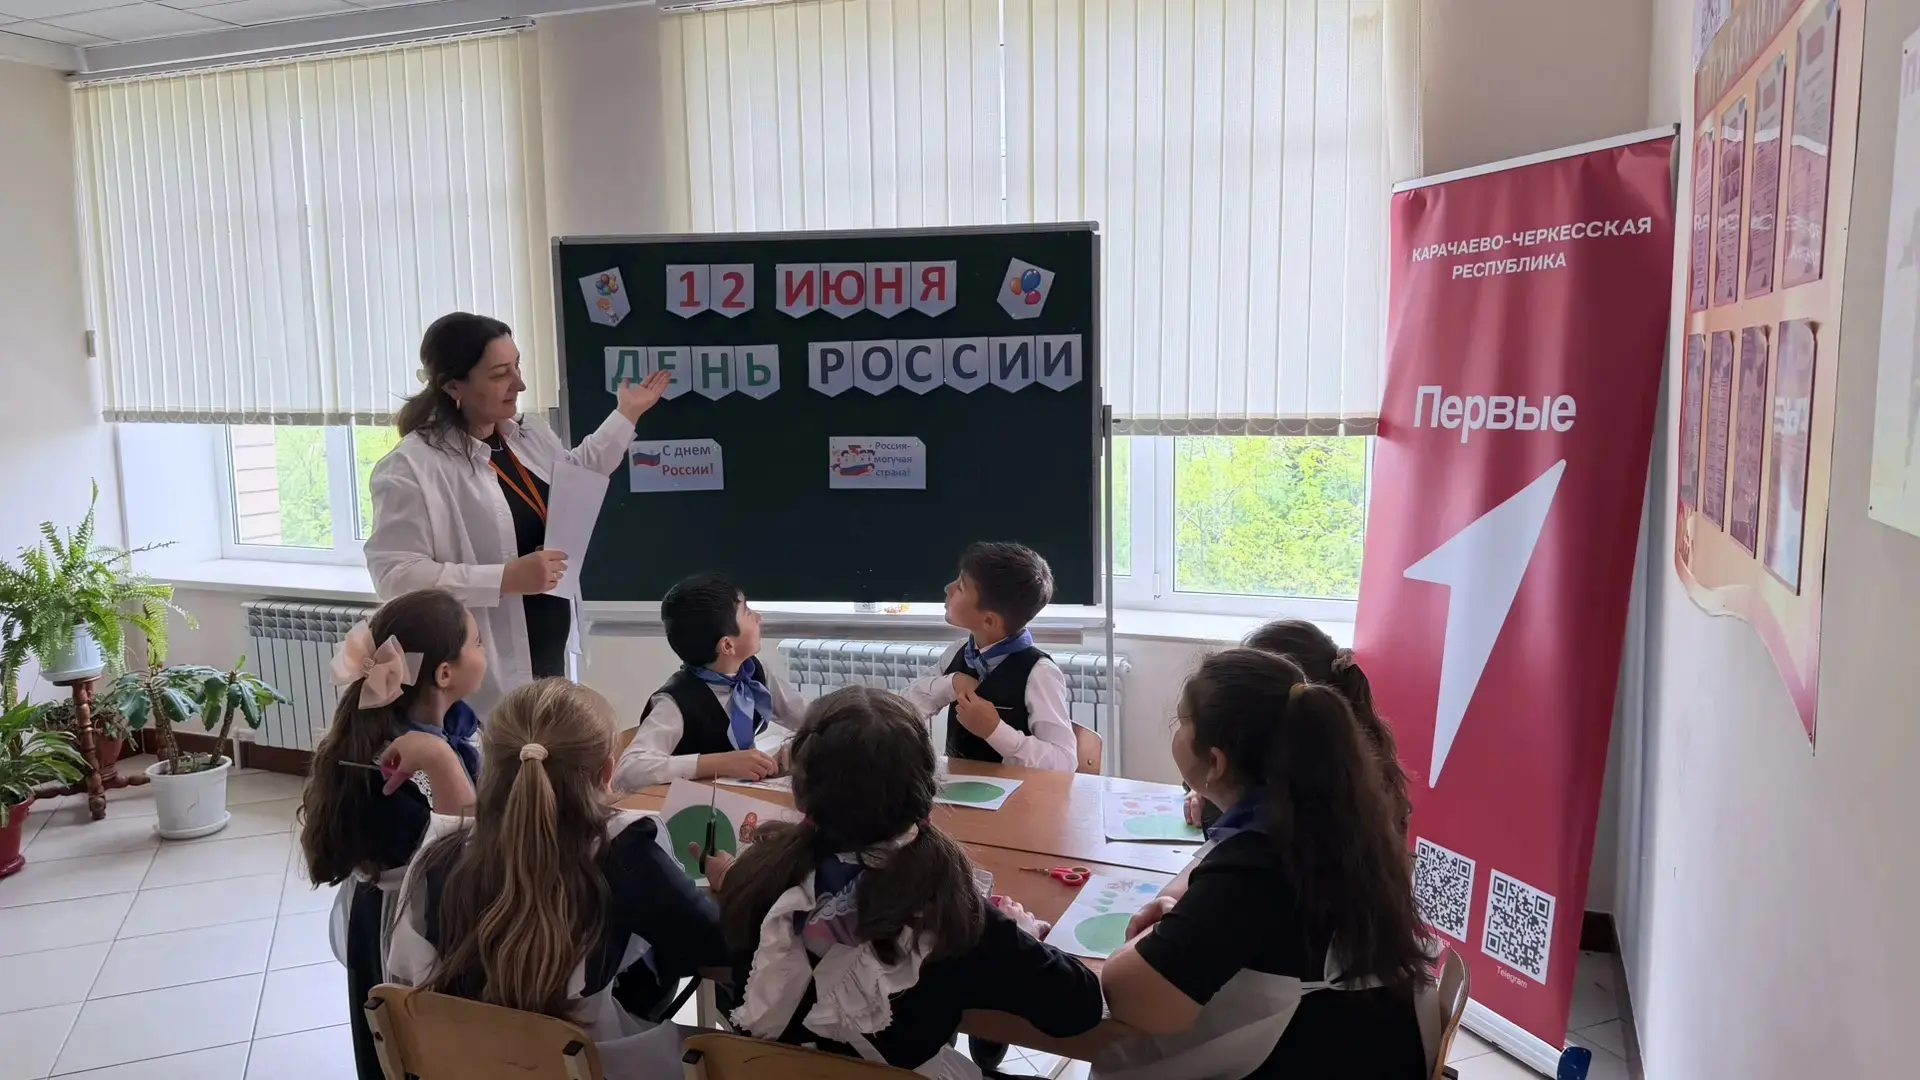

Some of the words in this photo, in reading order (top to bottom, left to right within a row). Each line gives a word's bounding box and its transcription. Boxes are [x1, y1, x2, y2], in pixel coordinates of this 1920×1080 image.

[1412, 216, 1652, 262] КАРАЧАЕВО-ЧЕРКЕССКАЯ
[1452, 252, 1567, 280] РЕСПУБЛИКА
[679, 270, 746, 308] 12
[784, 266, 946, 307] ИЮНЯ
[611, 349, 772, 390] ДЕНЬ
[821, 340, 1073, 384] РОССИИ
[1413, 385, 1577, 444] Первые
[662, 444, 671, 456] С
[674, 445, 711, 458] днем
[874, 456, 913, 467] могучая
[662, 462, 714, 476] России!
[875, 468, 911, 479] страна!
[1497, 965, 1528, 988] Telegram
